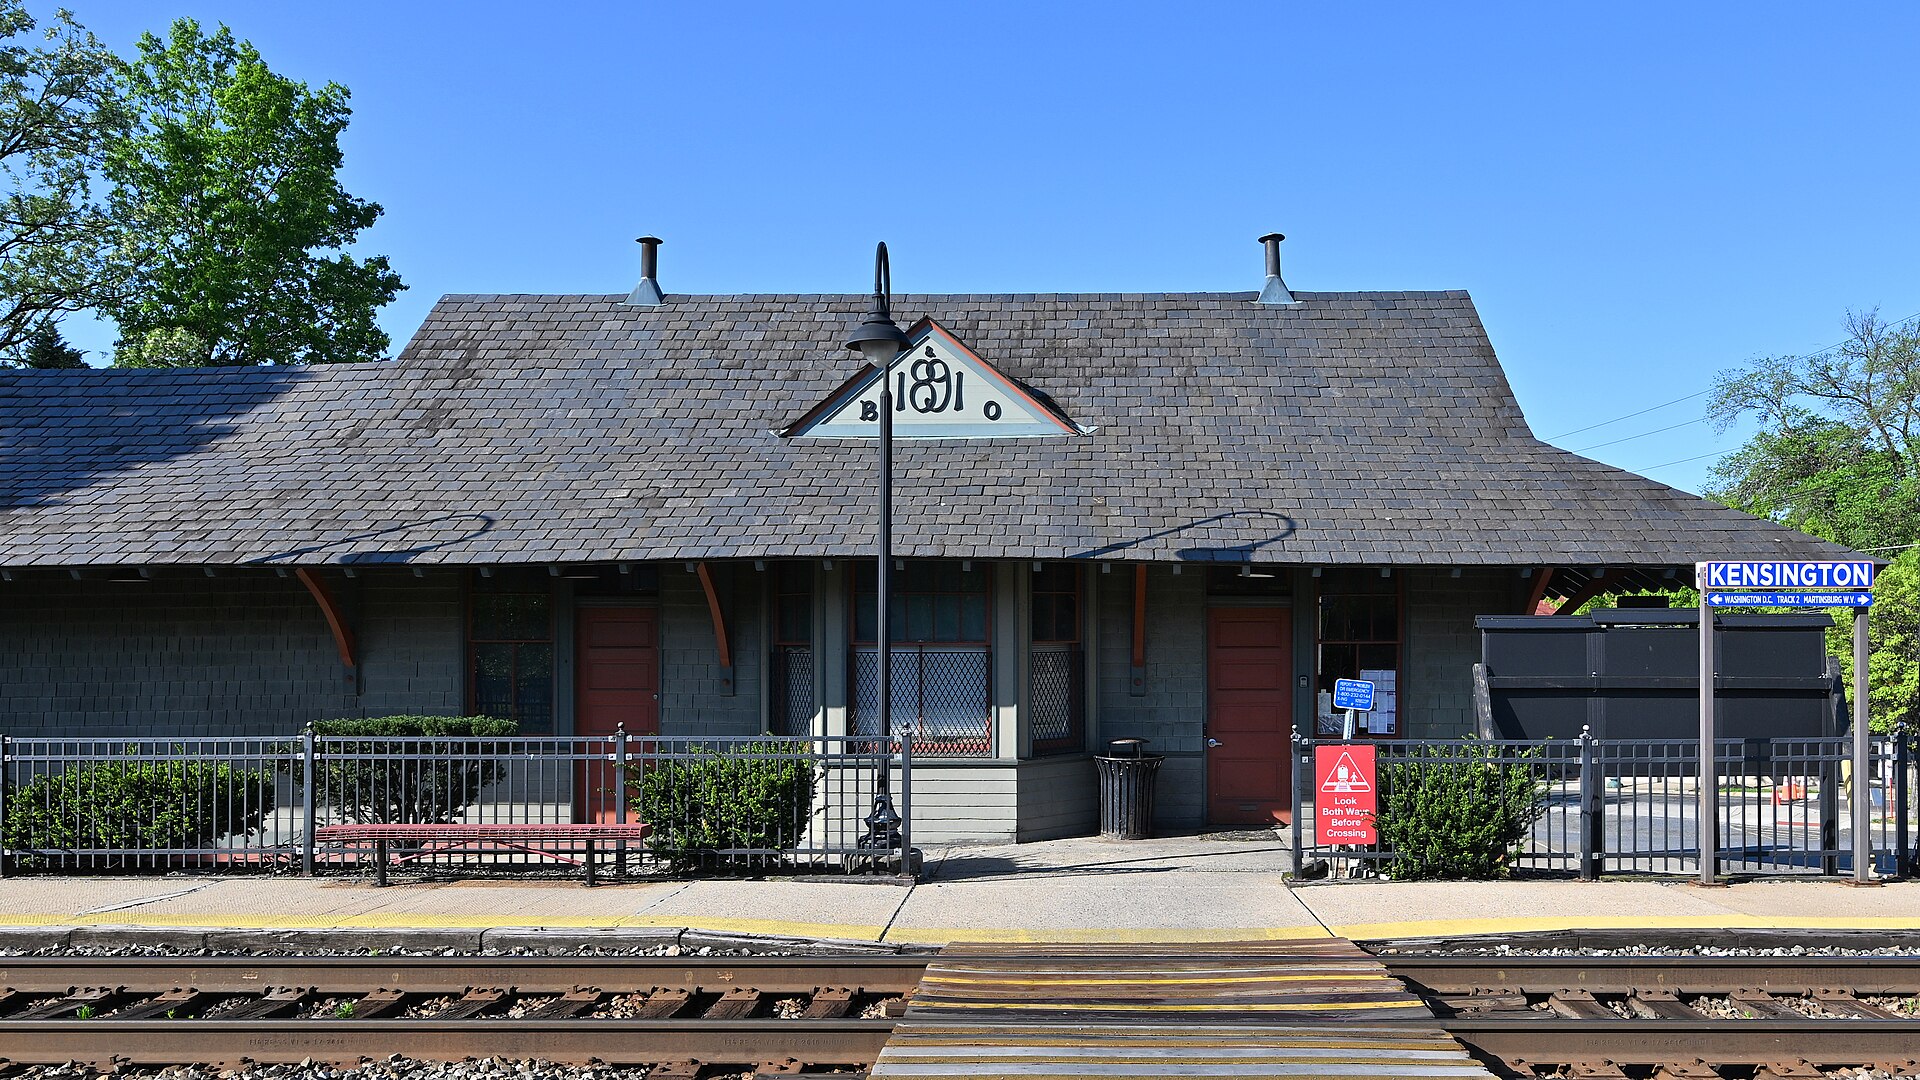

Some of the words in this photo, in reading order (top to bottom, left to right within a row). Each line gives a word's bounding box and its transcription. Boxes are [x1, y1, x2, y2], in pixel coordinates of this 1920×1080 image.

[896, 359, 964, 414] 1891
[859, 400, 879, 421] B
[983, 400, 1002, 421] O
[1710, 563, 1869, 586] KENSINGTON
[1724, 595, 1762, 604] WASHINGTON
[1762, 595, 1773, 604] D.C.
[1777, 595, 1795, 604] TRACK
[1795, 595, 1800, 604] 2
[1804, 595, 1843, 604] MARTINSBURG
[1334, 797, 1357, 805] Look
[1322, 807, 1344, 816] Both
[1331, 818, 1361, 827] Before
[1326, 829, 1367, 839] Crossing
